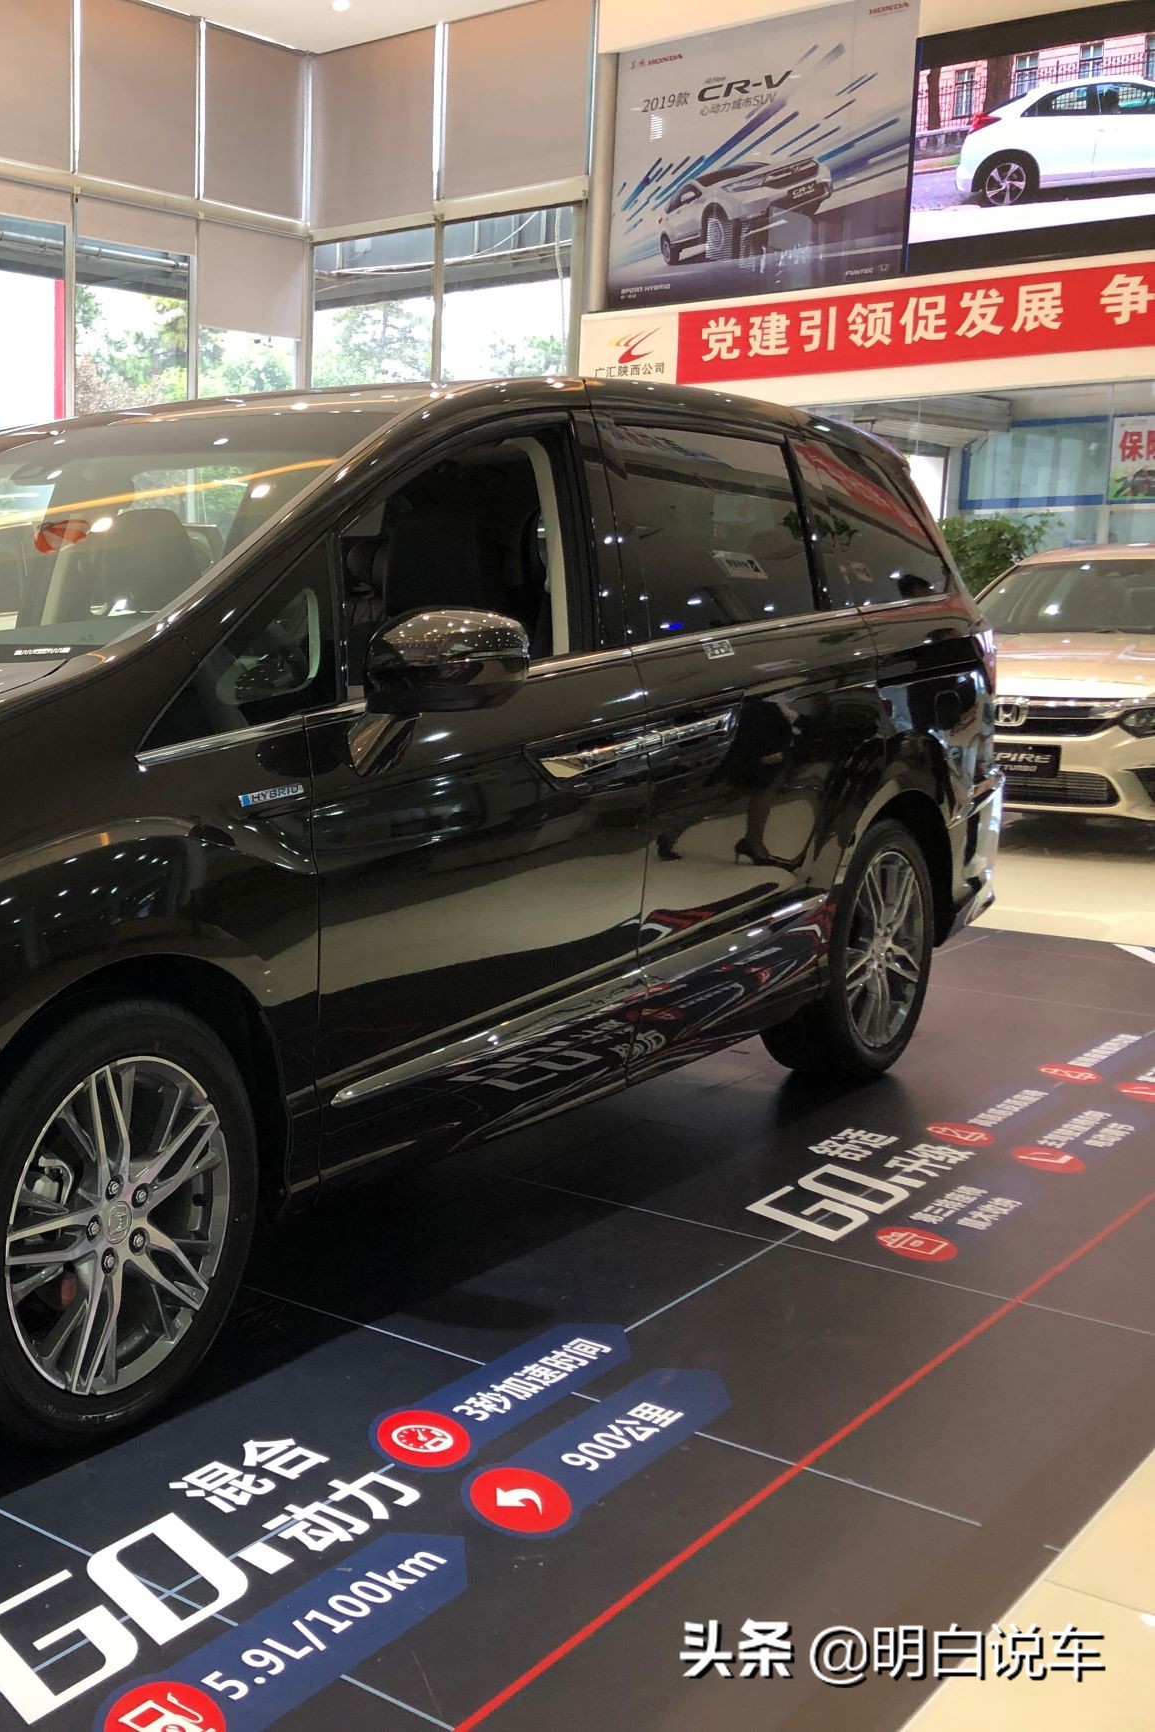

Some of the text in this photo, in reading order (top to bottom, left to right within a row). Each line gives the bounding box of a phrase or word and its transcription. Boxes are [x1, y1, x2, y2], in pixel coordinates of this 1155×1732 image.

[868, 2, 910, 15] HONDA
[648, 53, 683, 66] HONDA
[641, 91, 690, 113] 2019款
[698, 70, 793, 102] CR-V
[701, 273, 1155, 362] 党建引领促发展 争
[595, 362, 665, 378] 广汇陕西公司
[993, 752, 1052, 764] PIRE
[251, 784, 300, 802] HYBRID
[452, 1337, 613, 1422] 3秒加速时间
[560, 1402, 685, 1471] 900公里
[168, 1438, 330, 1513] 混合
[261, 1471, 421, 1551] 动力
[201, 1549, 448, 1701] 5.9L/100km
